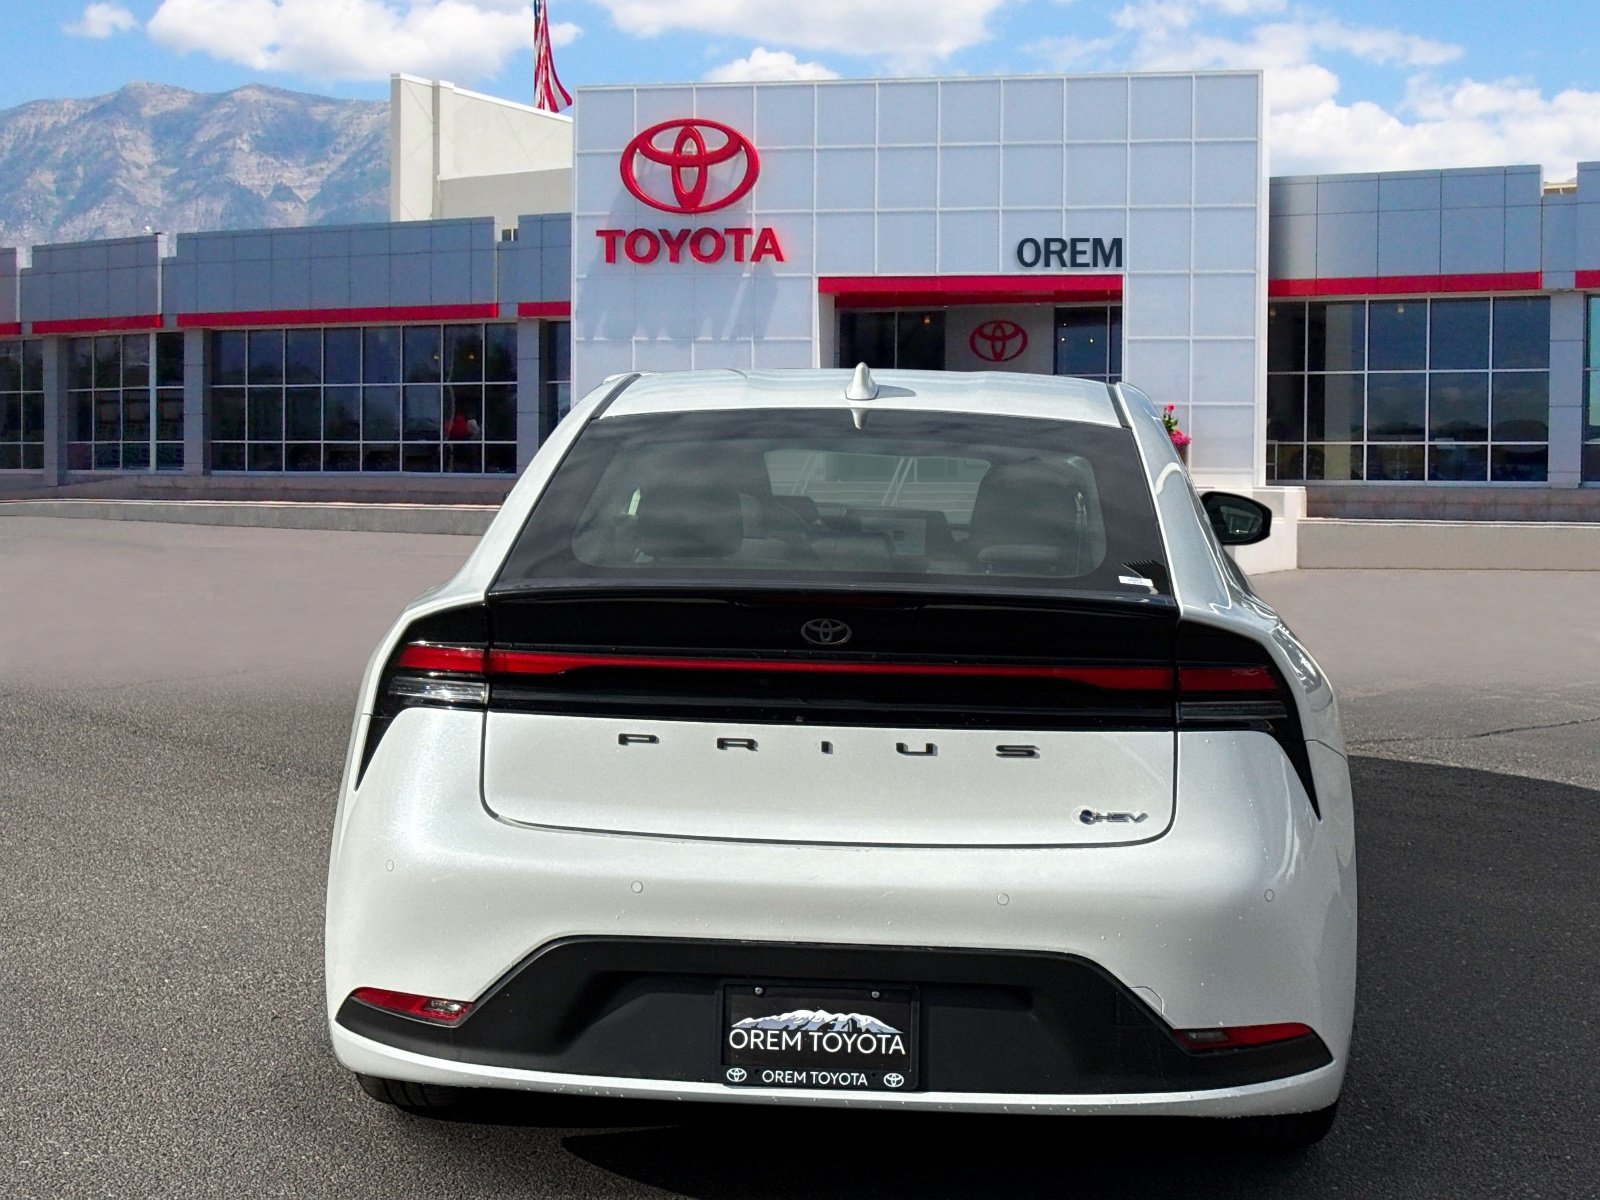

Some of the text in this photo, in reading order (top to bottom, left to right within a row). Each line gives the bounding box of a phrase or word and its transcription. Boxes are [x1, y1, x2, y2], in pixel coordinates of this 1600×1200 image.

[596, 227, 785, 264] TOYOTA
[1016, 237, 1123, 269] OREM
[618, 733, 1041, 759] PRIUS
[729, 1028, 906, 1055] OREM TOYOTA
[762, 1069, 868, 1086] OREM TOYOTA
